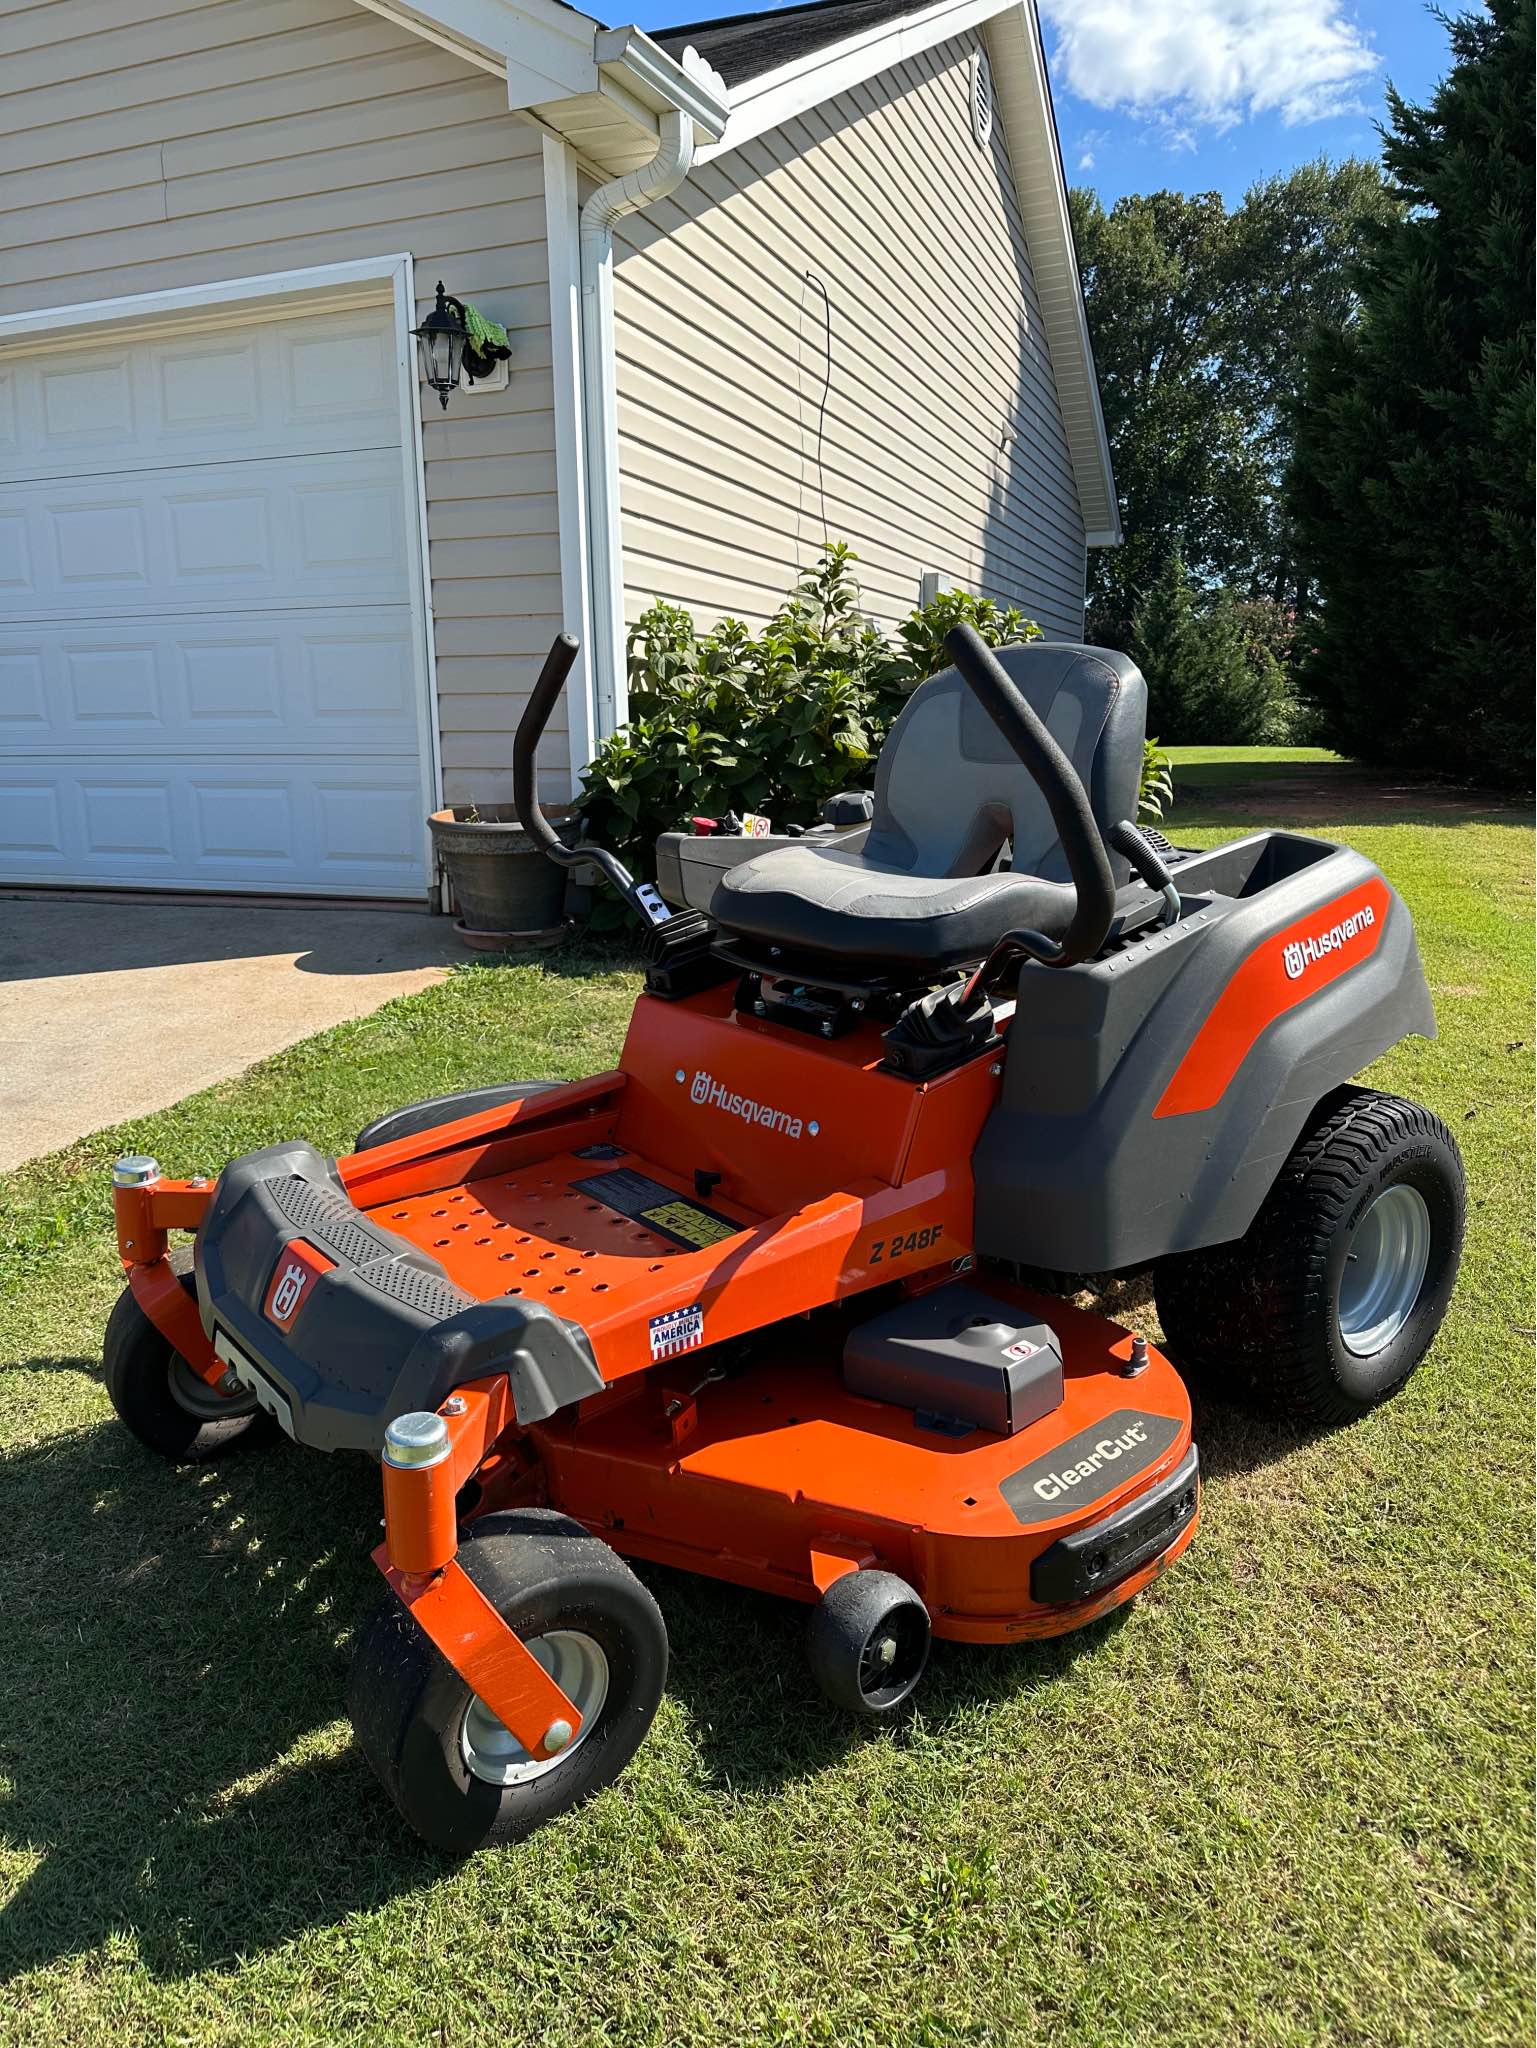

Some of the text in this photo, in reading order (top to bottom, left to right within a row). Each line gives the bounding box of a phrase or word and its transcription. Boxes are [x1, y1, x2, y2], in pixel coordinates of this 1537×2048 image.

[1300, 905, 1375, 966] Husqvarna
[708, 1081, 803, 1140] Husqvarna
[870, 1223, 944, 1264] Z 248F
[653, 1319, 701, 1345] AMERICA
